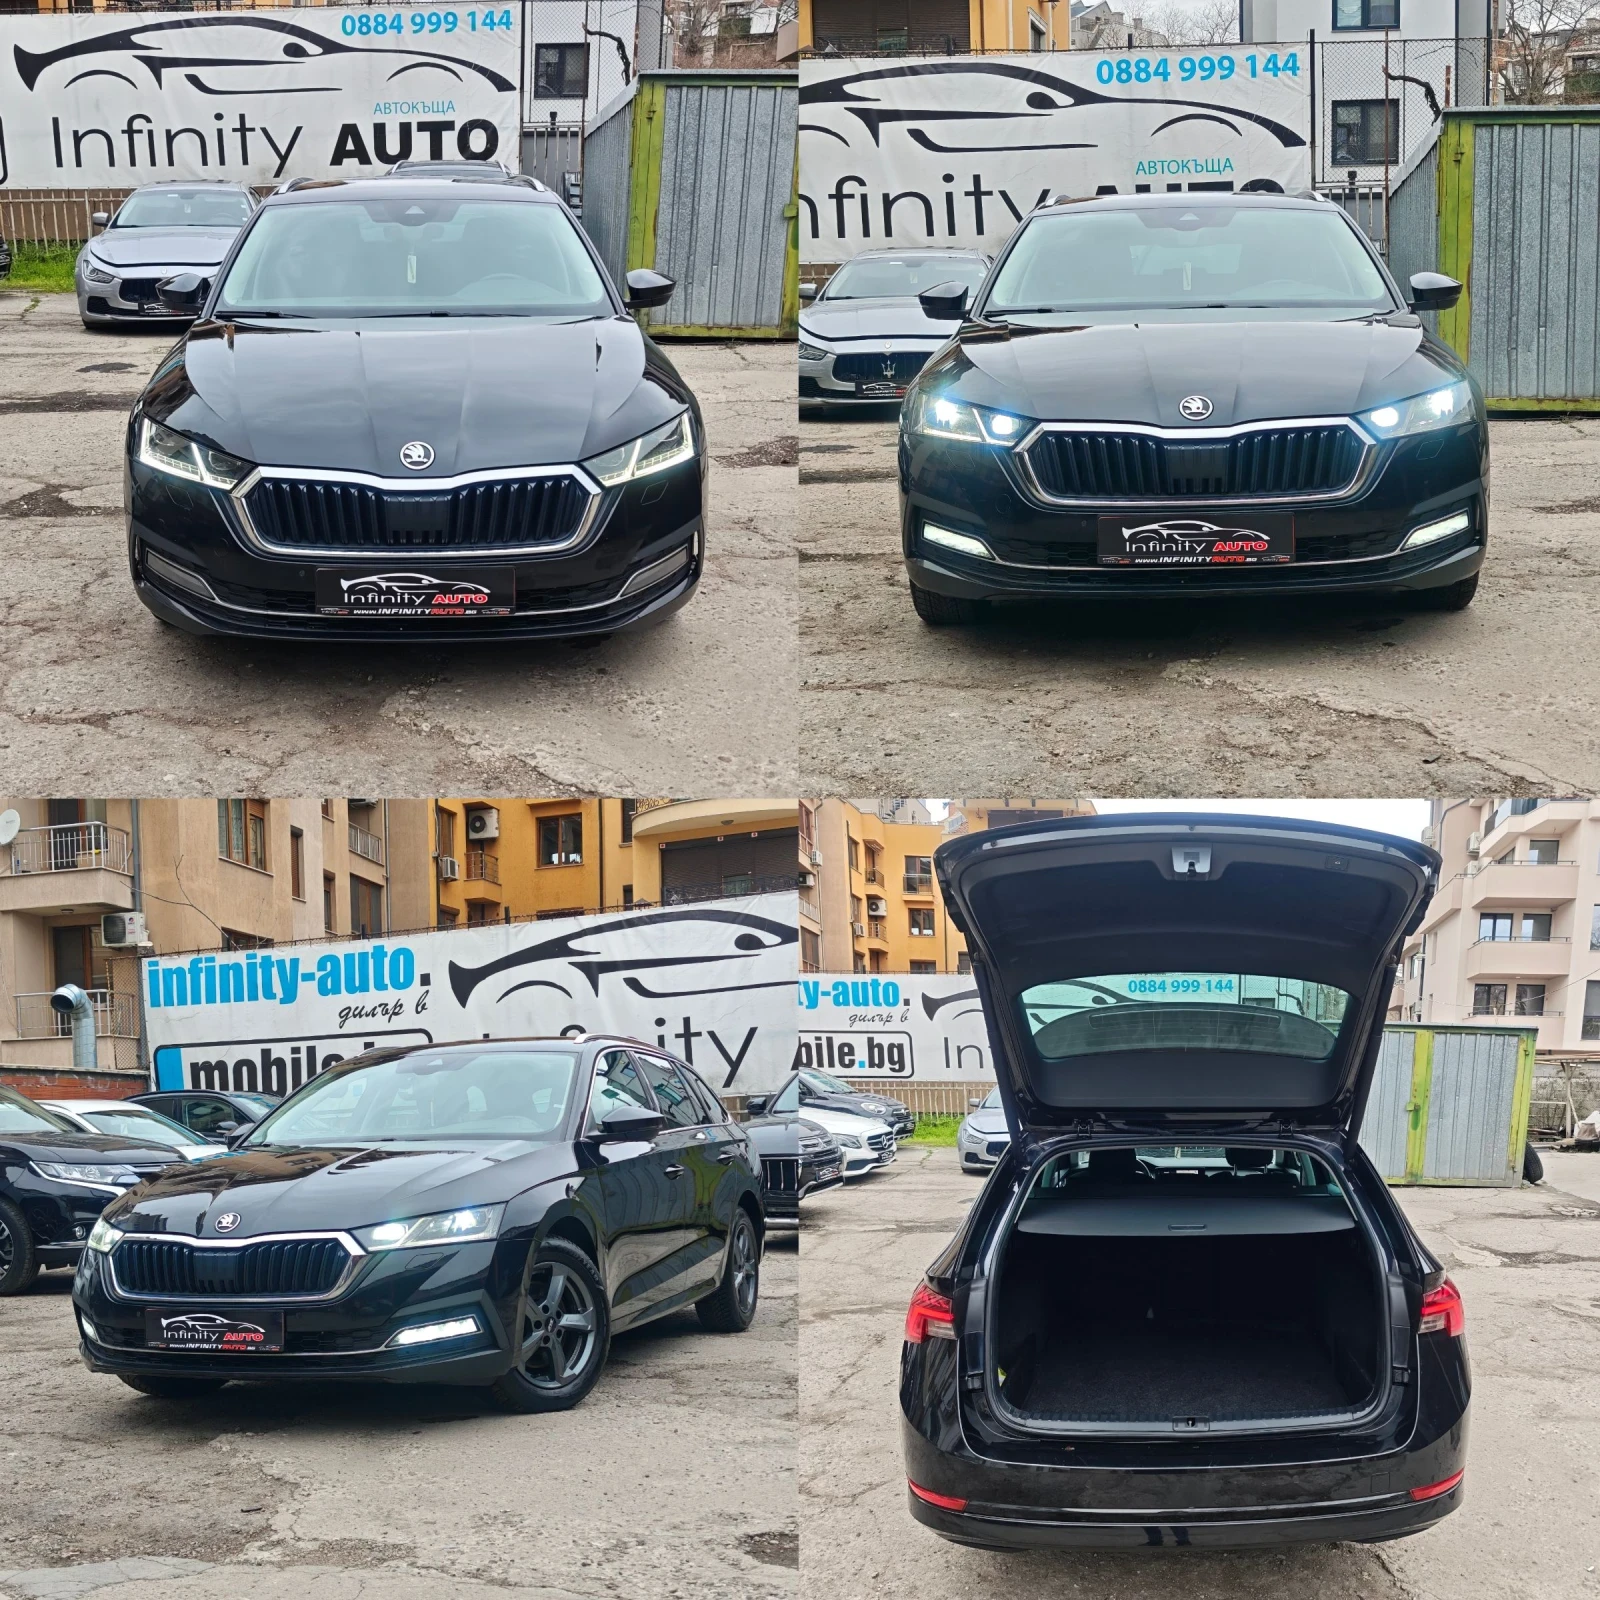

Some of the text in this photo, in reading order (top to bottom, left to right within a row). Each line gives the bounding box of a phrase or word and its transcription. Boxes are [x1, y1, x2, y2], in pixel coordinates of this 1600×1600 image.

[341, 9, 512, 36] 0884 999 144
[1096, 52, 1300, 85] 0884 999 144
[373, 100, 456, 115] АВТОКЪЩА
[51, 112, 499, 178] Infinity AUTO
[1135, 157, 1234, 175] АВТОКЪЩА
[1126, 541, 1268, 553] Infinity AUTO
[344, 592, 488, 605] Infinity AUTO
[798, 978, 910, 1010] y-auto.
[1128, 979, 1233, 993] 0884 999 144
[163, 1329, 264, 1341] Infinity AUTO
